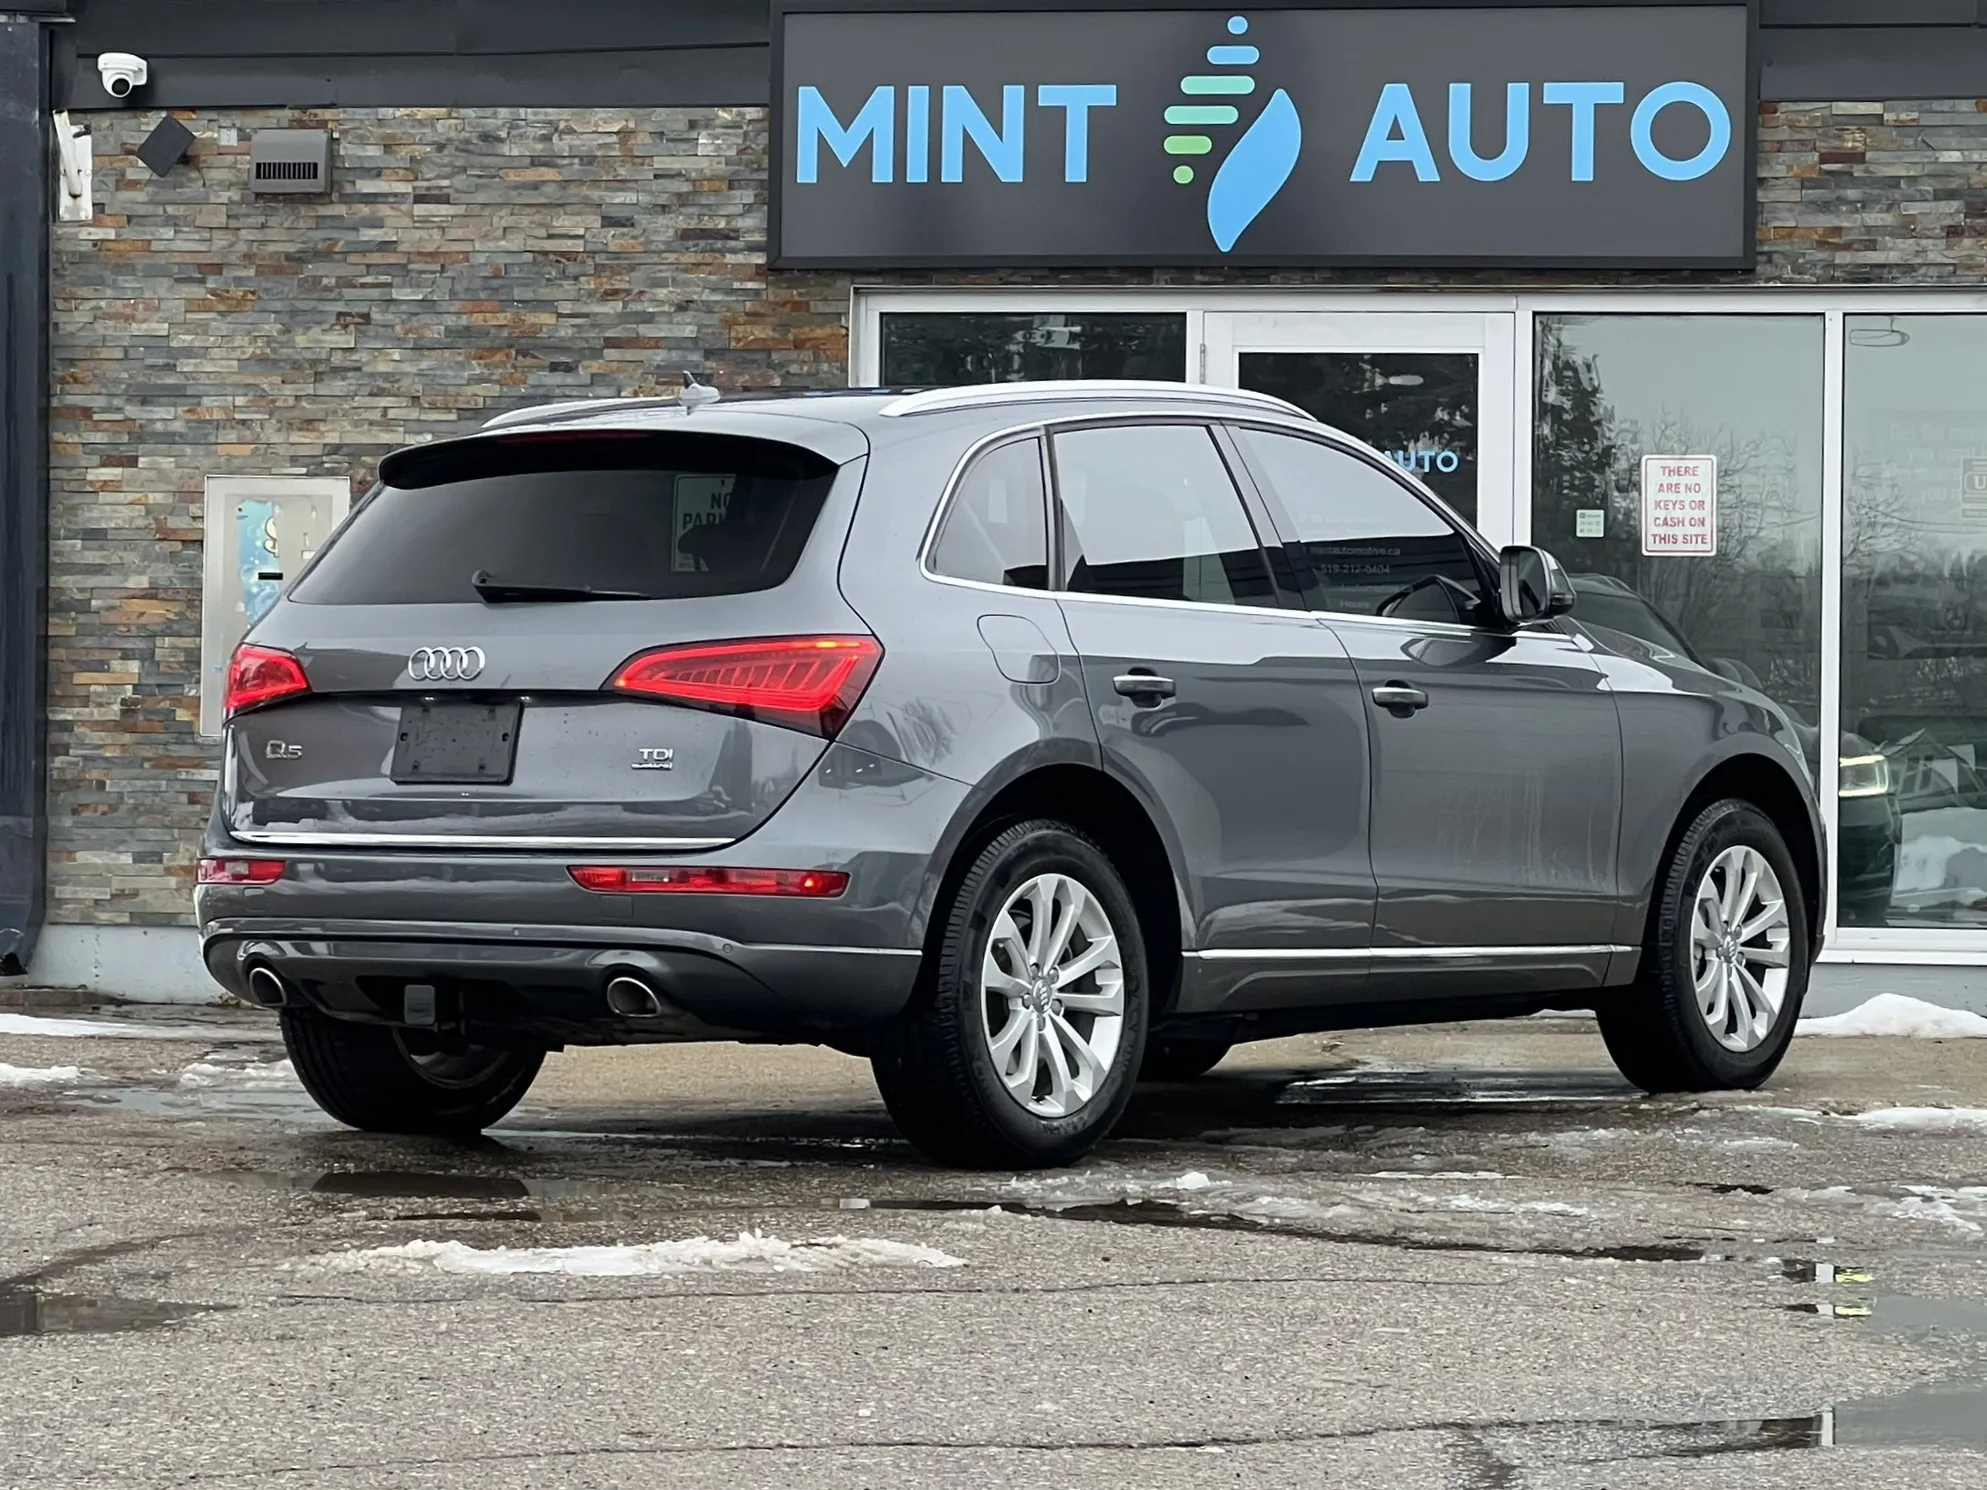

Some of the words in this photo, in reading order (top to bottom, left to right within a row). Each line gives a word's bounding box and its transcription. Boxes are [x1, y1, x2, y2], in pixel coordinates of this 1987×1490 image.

[796, 85, 1118, 184] MINT
[1350, 80, 1732, 183] AUTO
[1660, 466, 1699, 476] THERE
[1658, 483, 1681, 494] ARE
[1684, 483, 1701, 494] NO
[1654, 500, 1685, 511] KEYS
[1689, 500, 1705, 511] OR
[682, 512, 724, 531] PAR
[1654, 517, 1685, 528] CASH
[1689, 517, 1706, 528] ON
[1652, 534, 1679, 545] THIS
[1682, 534, 1708, 545] SITE
[266, 740, 302, 758] Q5
[638, 748, 674, 760] TDI
